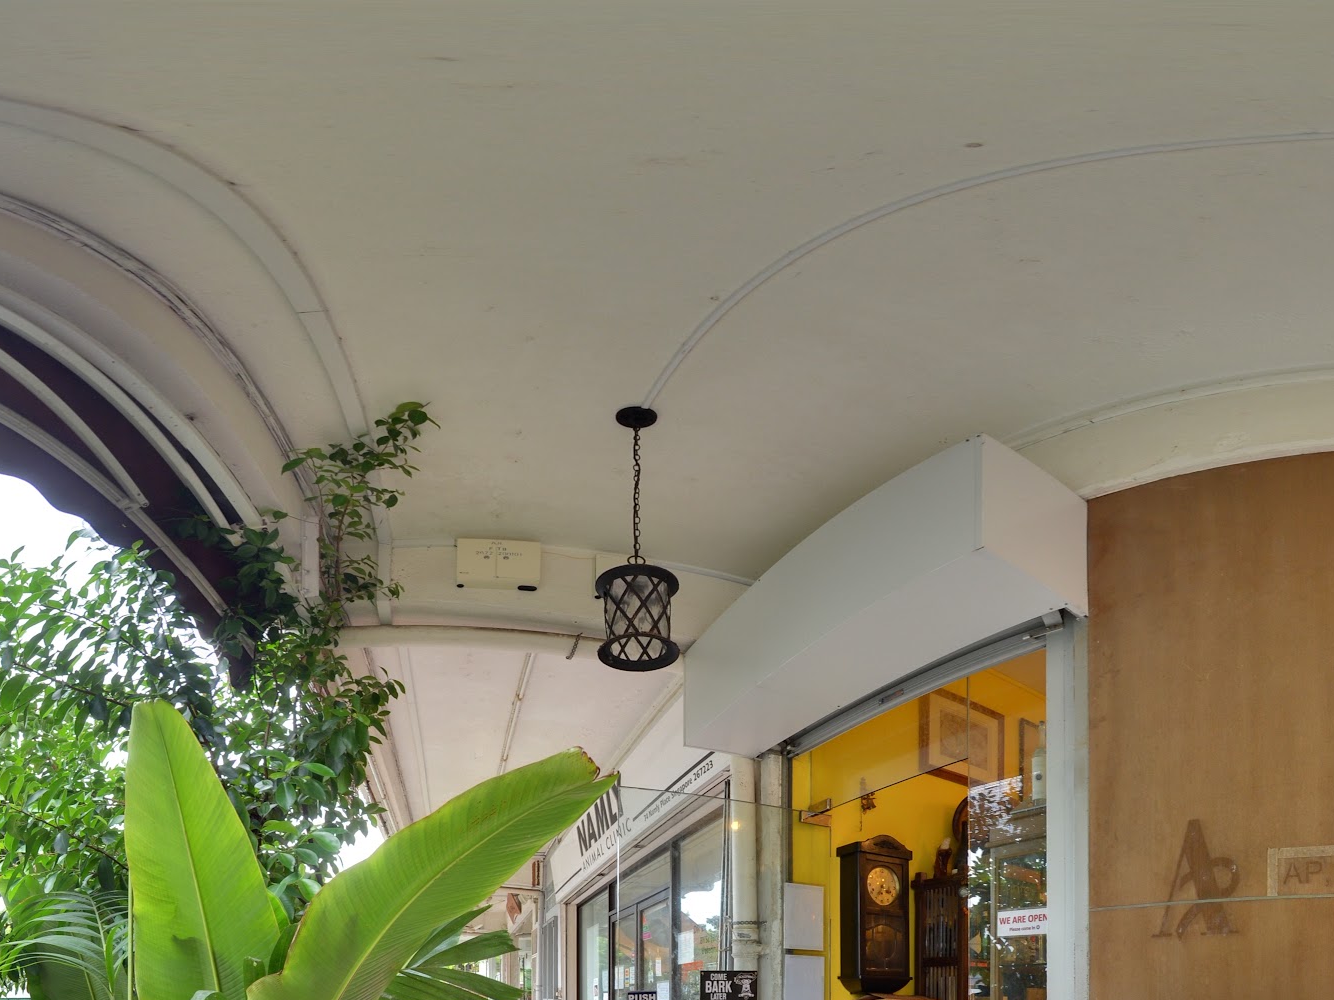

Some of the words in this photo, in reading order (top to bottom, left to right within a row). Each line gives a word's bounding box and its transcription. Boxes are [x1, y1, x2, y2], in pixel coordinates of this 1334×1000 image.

[660, 796, 671, 808] Place
[671, 777, 693, 800] Singapore
[692, 759, 714, 782] 267223
[581, 849, 605, 873] ANIMAL
[605, 817, 632, 850] CLINIC
[999, 917, 1010, 925] WE
[1012, 915, 1026, 923] ARE
[1028, 913, 1047, 922] OPEN
[710, 973, 727, 981] COME
[705, 980, 732, 993] BARK
[710, 992, 727, 1000] LATER
